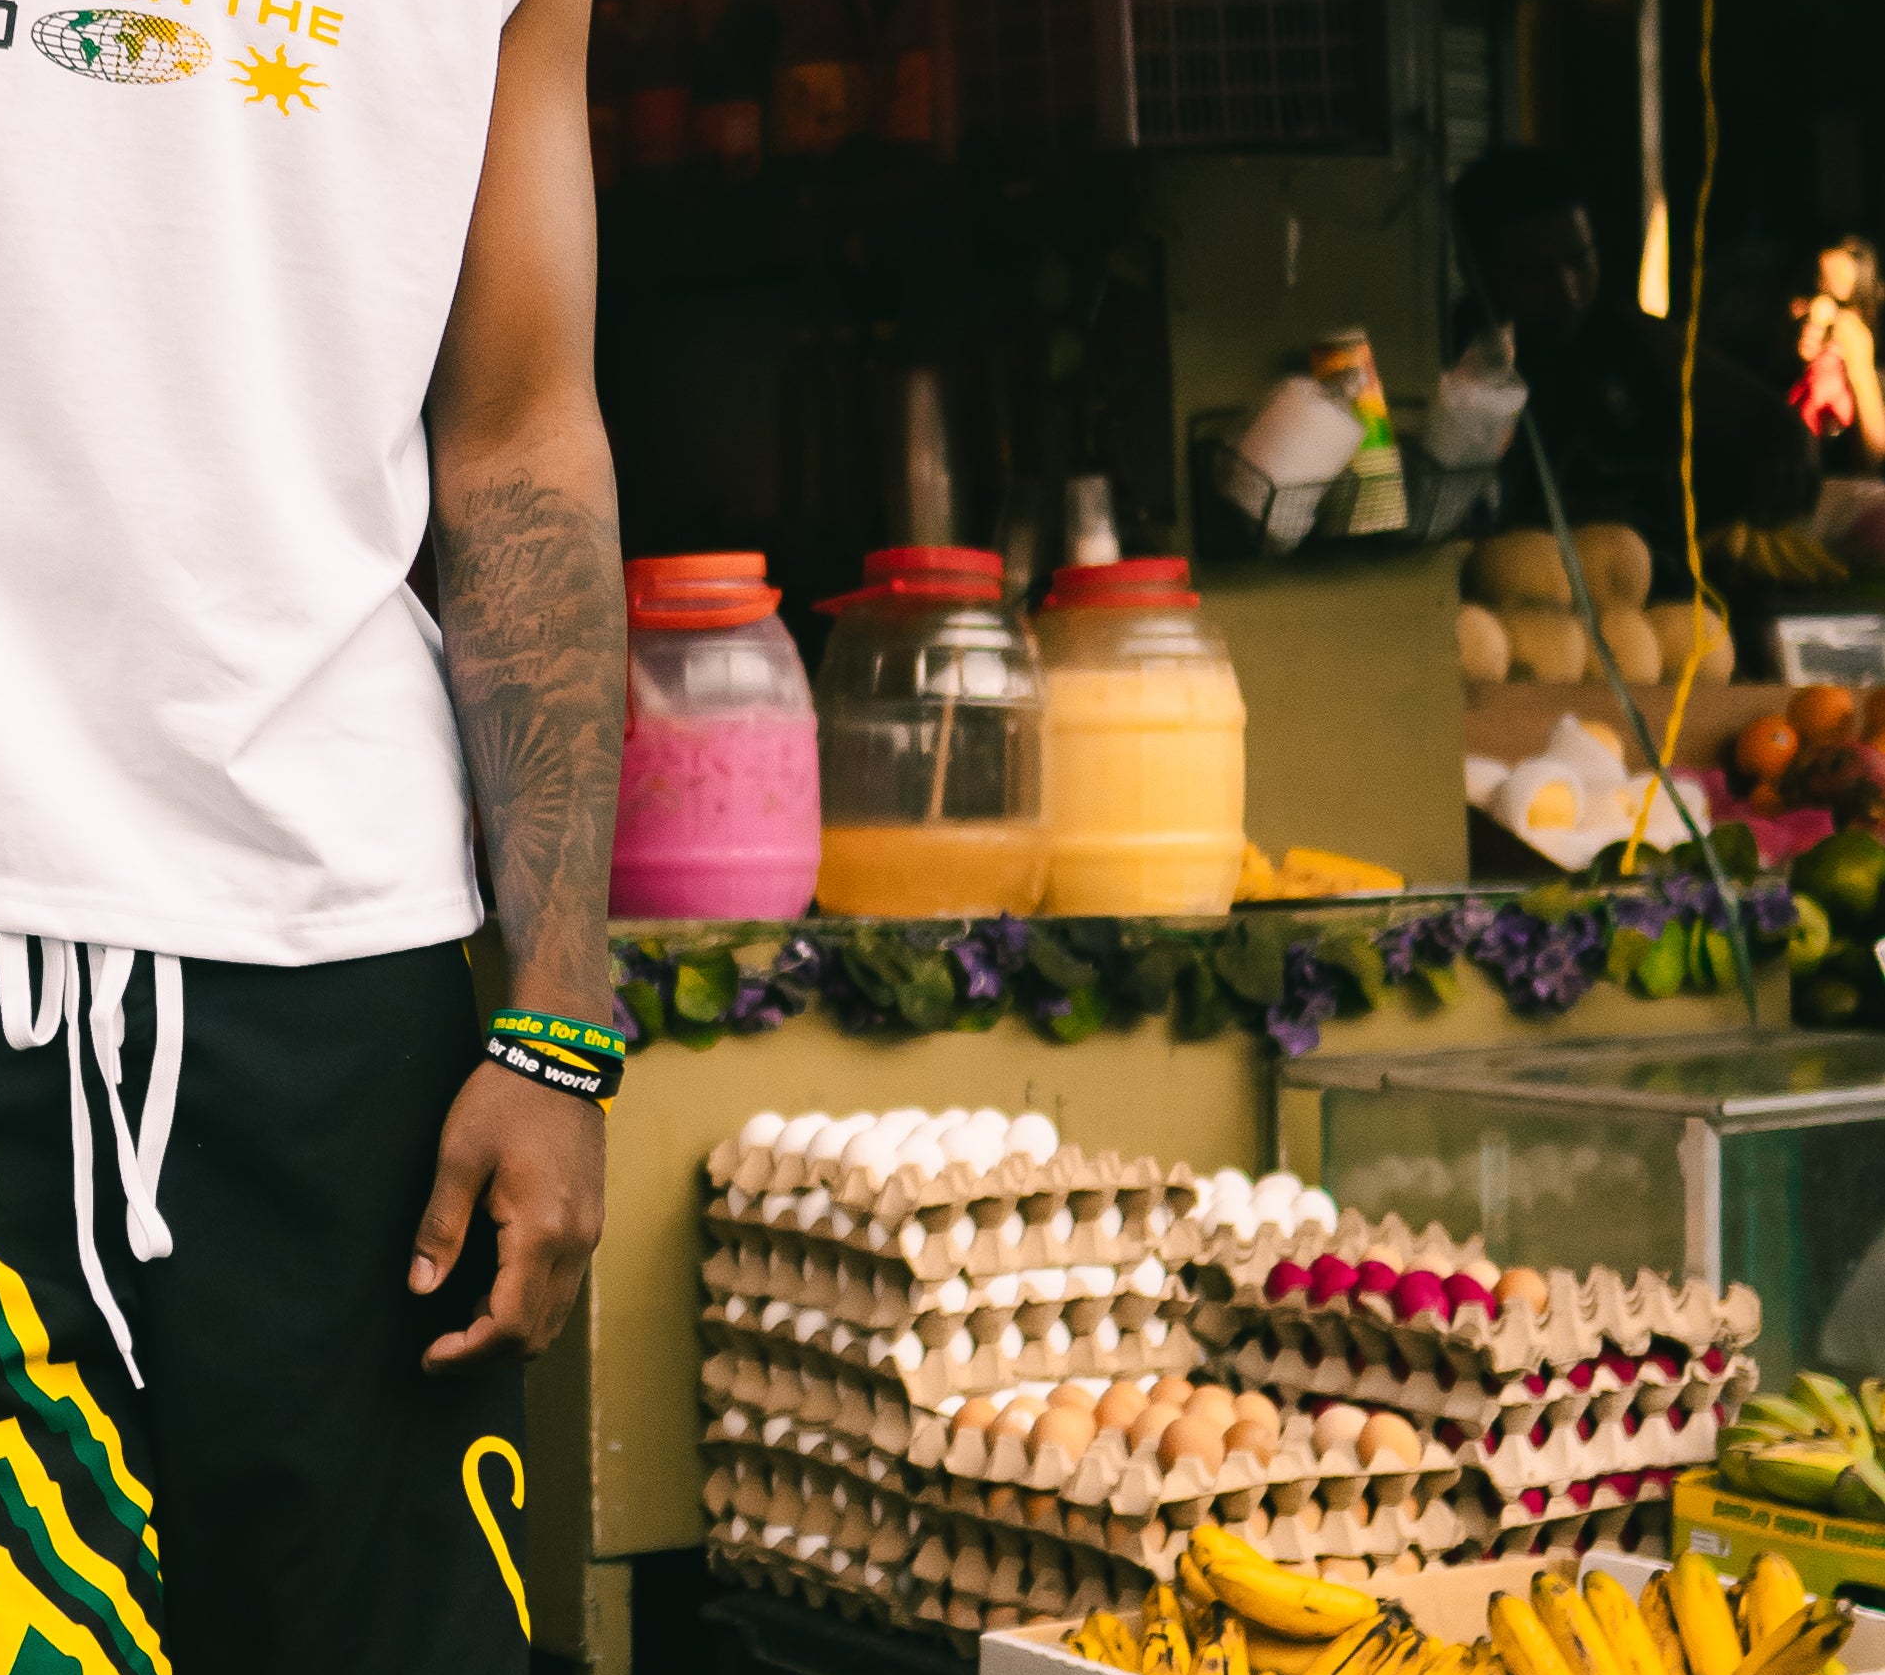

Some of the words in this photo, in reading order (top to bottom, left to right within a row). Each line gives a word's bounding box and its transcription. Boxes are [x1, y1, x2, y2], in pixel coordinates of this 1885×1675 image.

[494, 1016, 544, 1034] made
[549, 1021, 580, 1041] for
[584, 1028, 611, 1049] the
[506, 1046, 540, 1072] the
[544, 1065, 602, 1093] world
